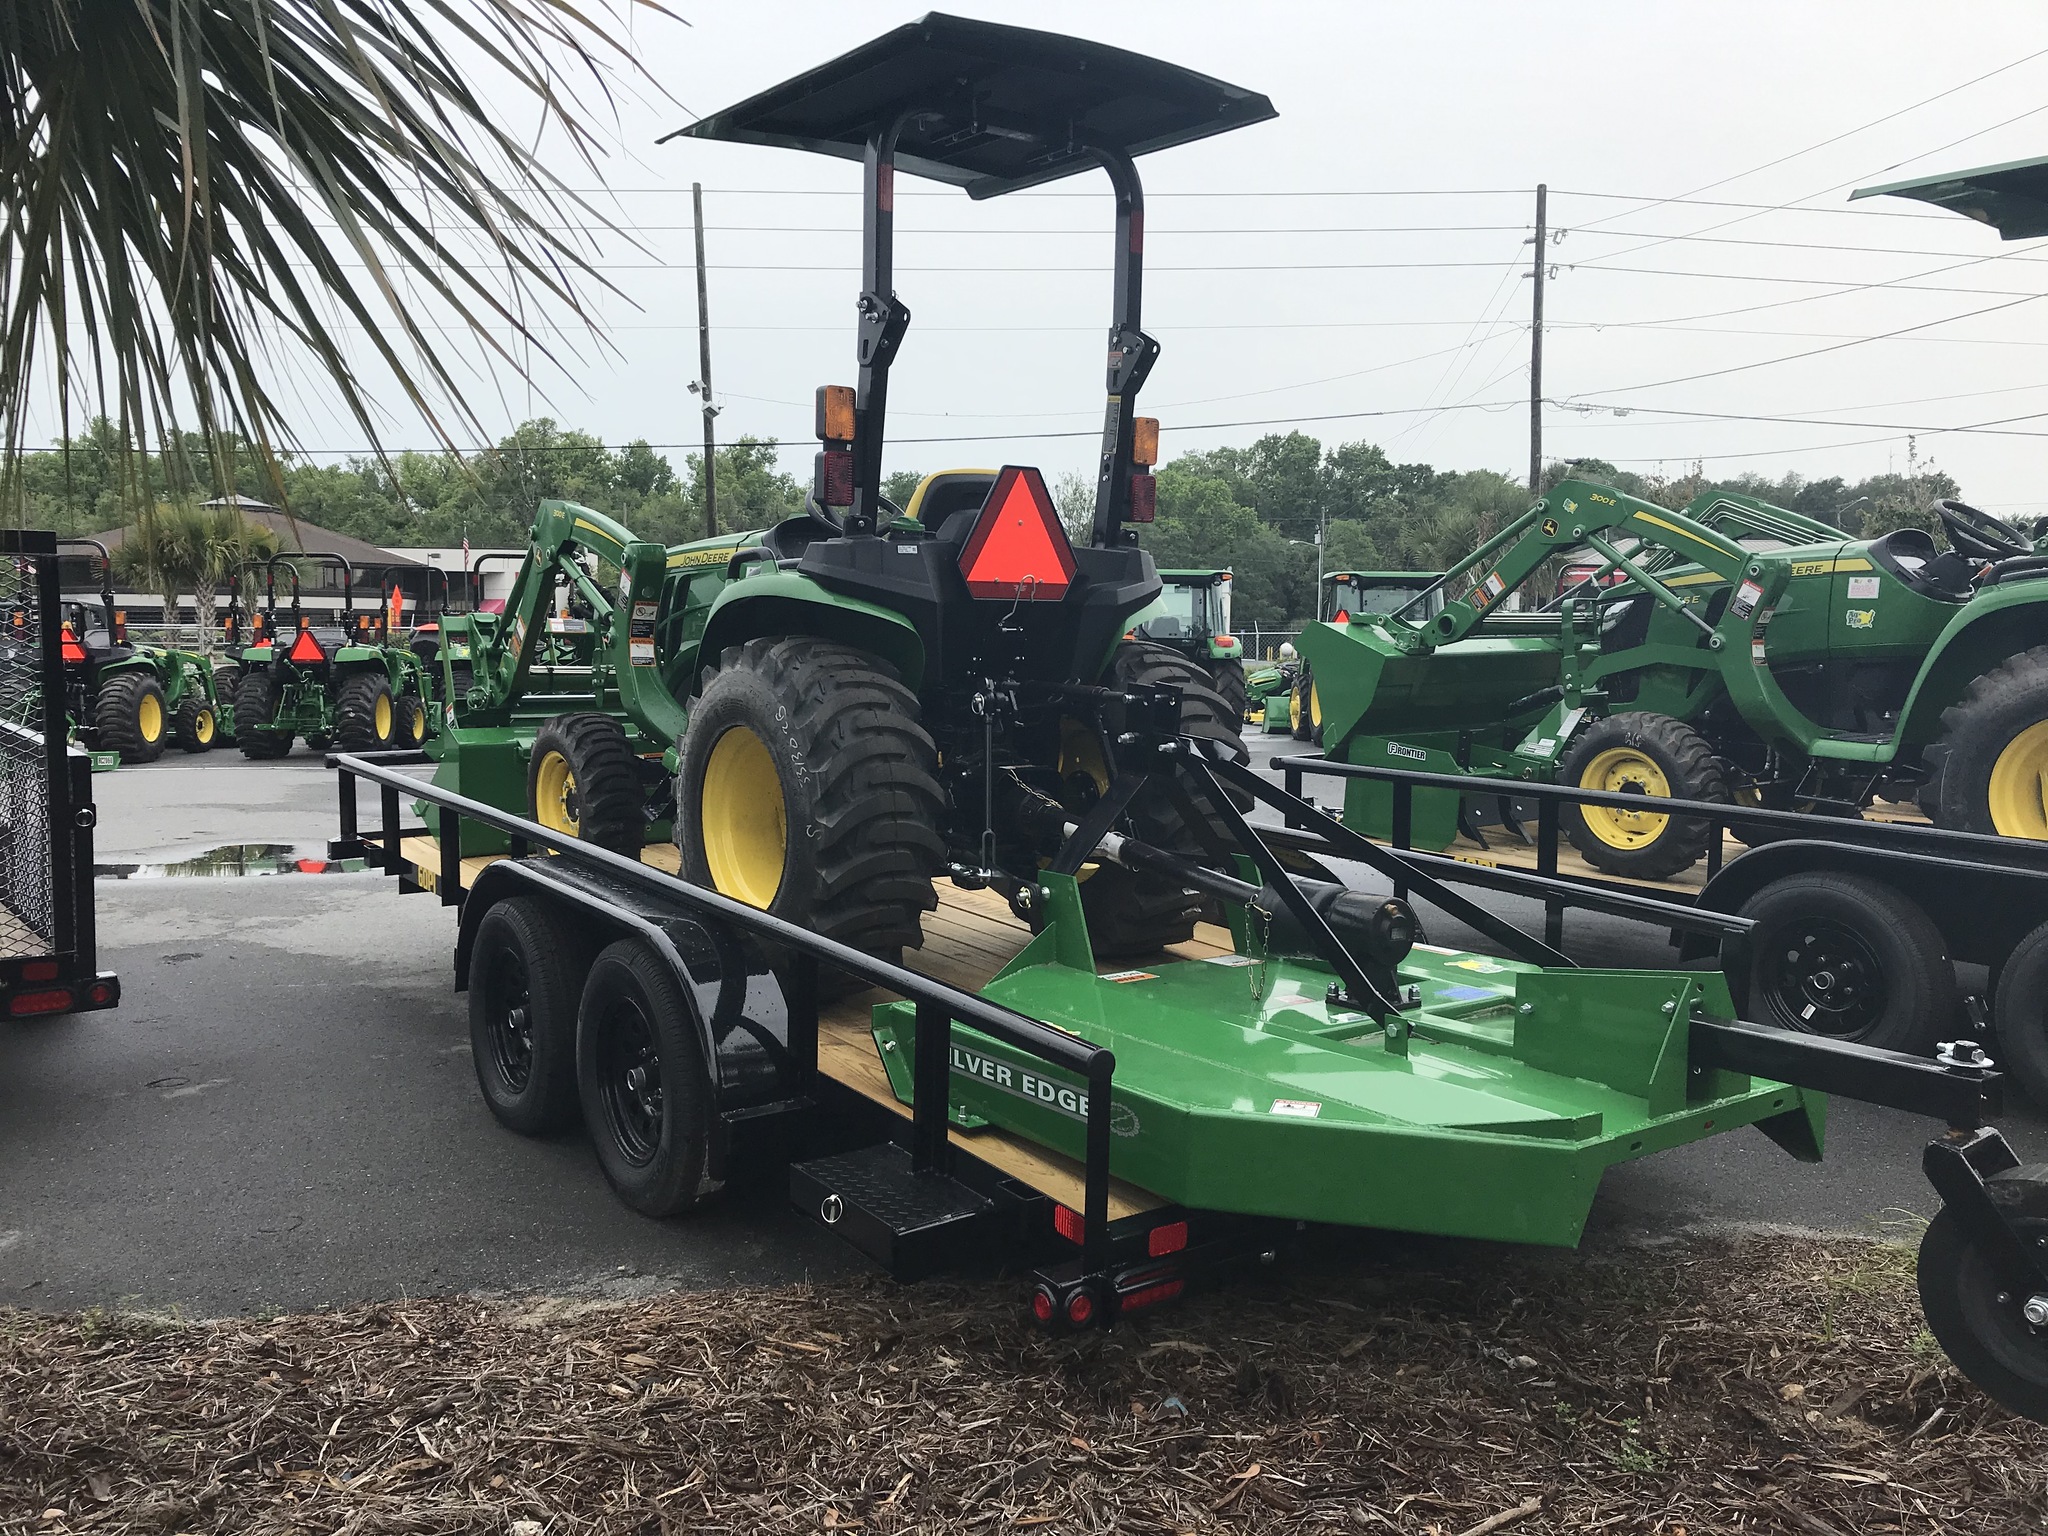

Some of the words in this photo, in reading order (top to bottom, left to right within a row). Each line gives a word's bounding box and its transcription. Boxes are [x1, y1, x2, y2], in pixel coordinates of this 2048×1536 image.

[680, 555, 701, 566] JOHN
[701, 552, 730, 563] DEERE
[1388, 742, 1426, 760] FRONTIER
[1022, 1073, 1089, 1117] EDGE
